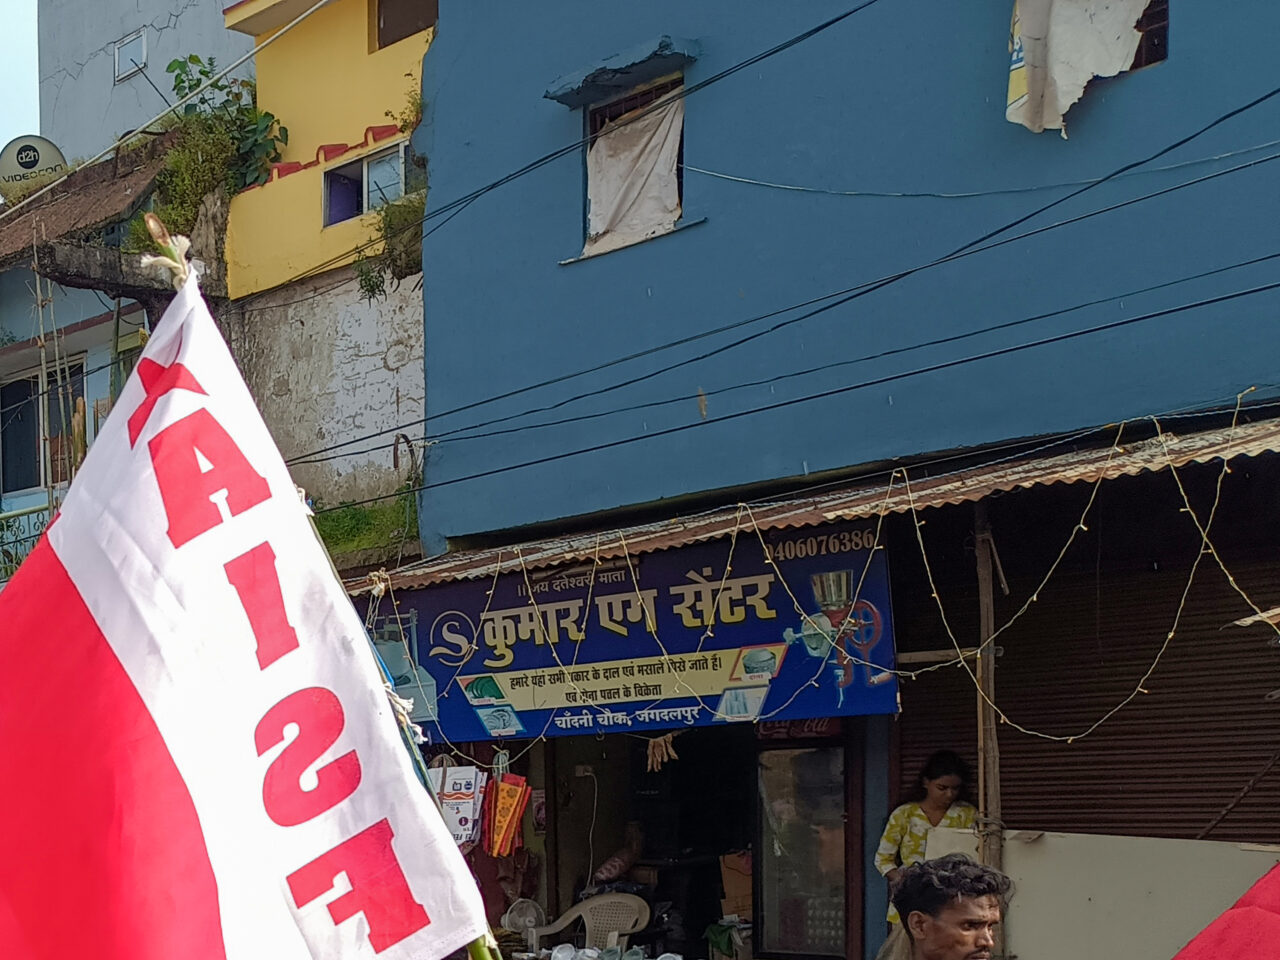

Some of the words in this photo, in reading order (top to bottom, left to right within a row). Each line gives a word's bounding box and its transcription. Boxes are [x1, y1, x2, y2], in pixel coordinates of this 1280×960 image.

[18, 150, 39, 163] d2h
[598, 569, 626, 584] माता
[480, 599, 586, 668] कुमार
[669, 566, 777, 629] सेंटर
[509, 673, 529, 689] हमारे
[548, 669, 566, 686] सभी
[592, 666, 601, 680] के
[603, 667, 620, 681] दाल
[622, 661, 636, 678] एवं
[637, 659, 665, 676] मसाले
[688, 655, 709, 671] जाते
[622, 683, 632, 698] के
[635, 706, 699, 725] जगदलपुर
